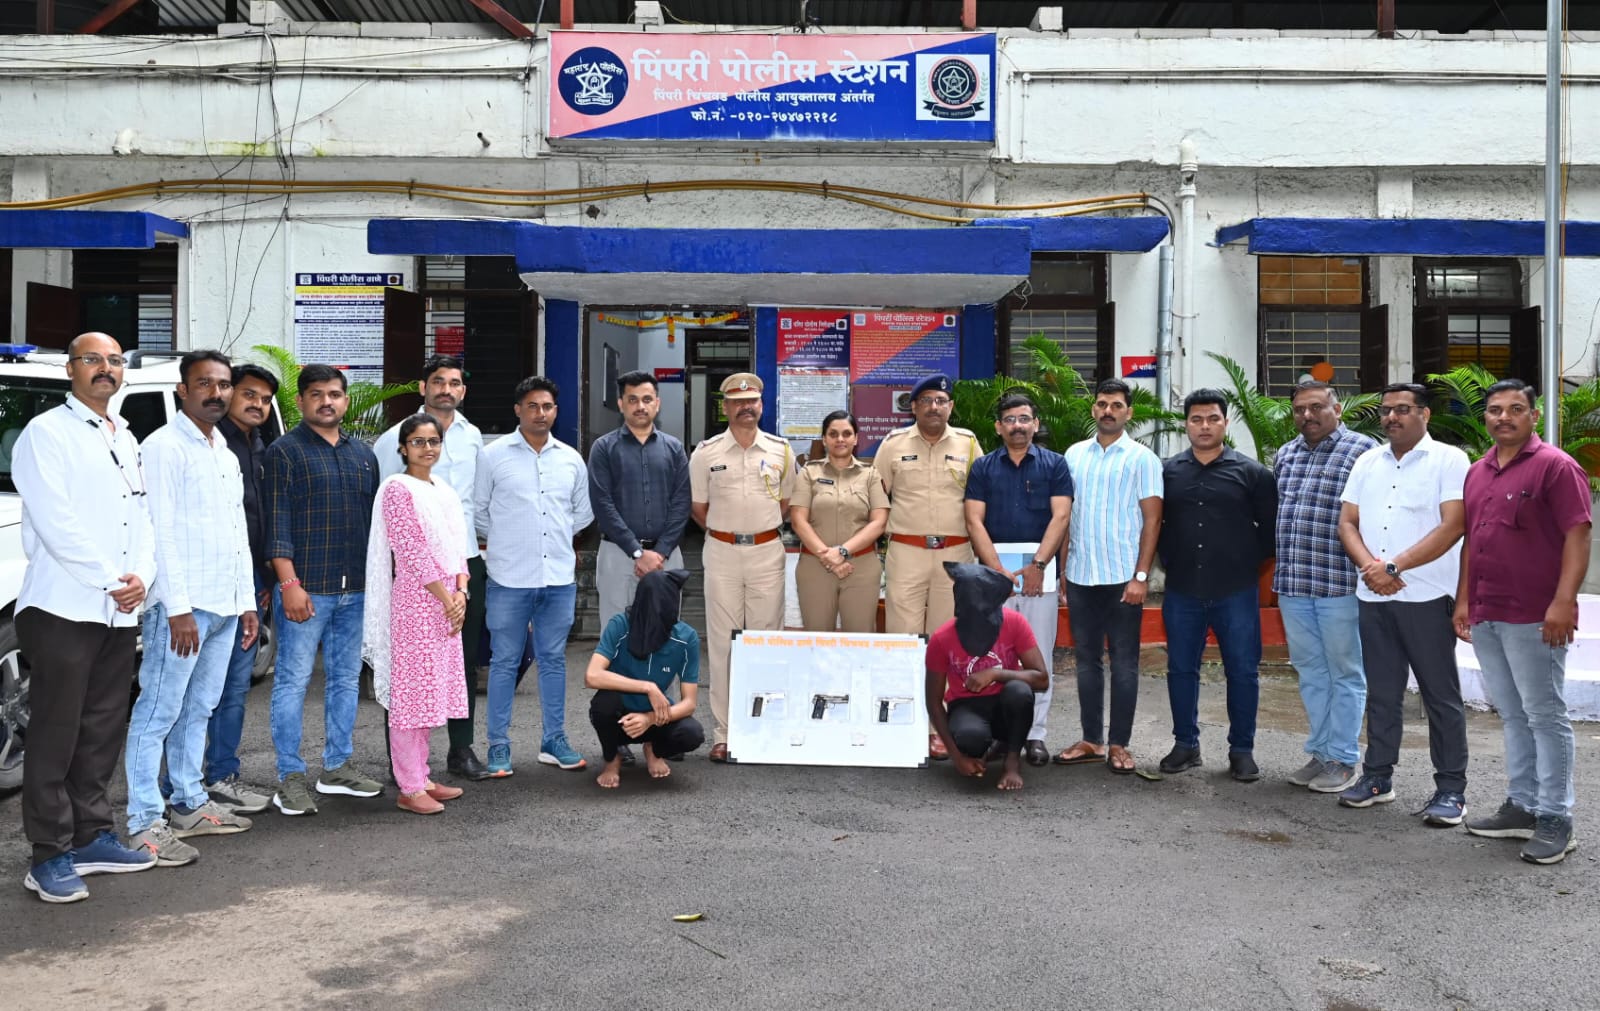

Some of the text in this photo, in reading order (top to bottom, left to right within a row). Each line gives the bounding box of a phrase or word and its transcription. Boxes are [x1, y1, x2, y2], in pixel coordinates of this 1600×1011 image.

[630, 48, 710, 82] पिंपरी
[720, 48, 817, 83] पोलीस
[828, 50, 910, 86] स्टेशन
[653, 87, 876, 106] पिंपरी चिंचवड पोलीस आयुक्तालय अंतर्गत
